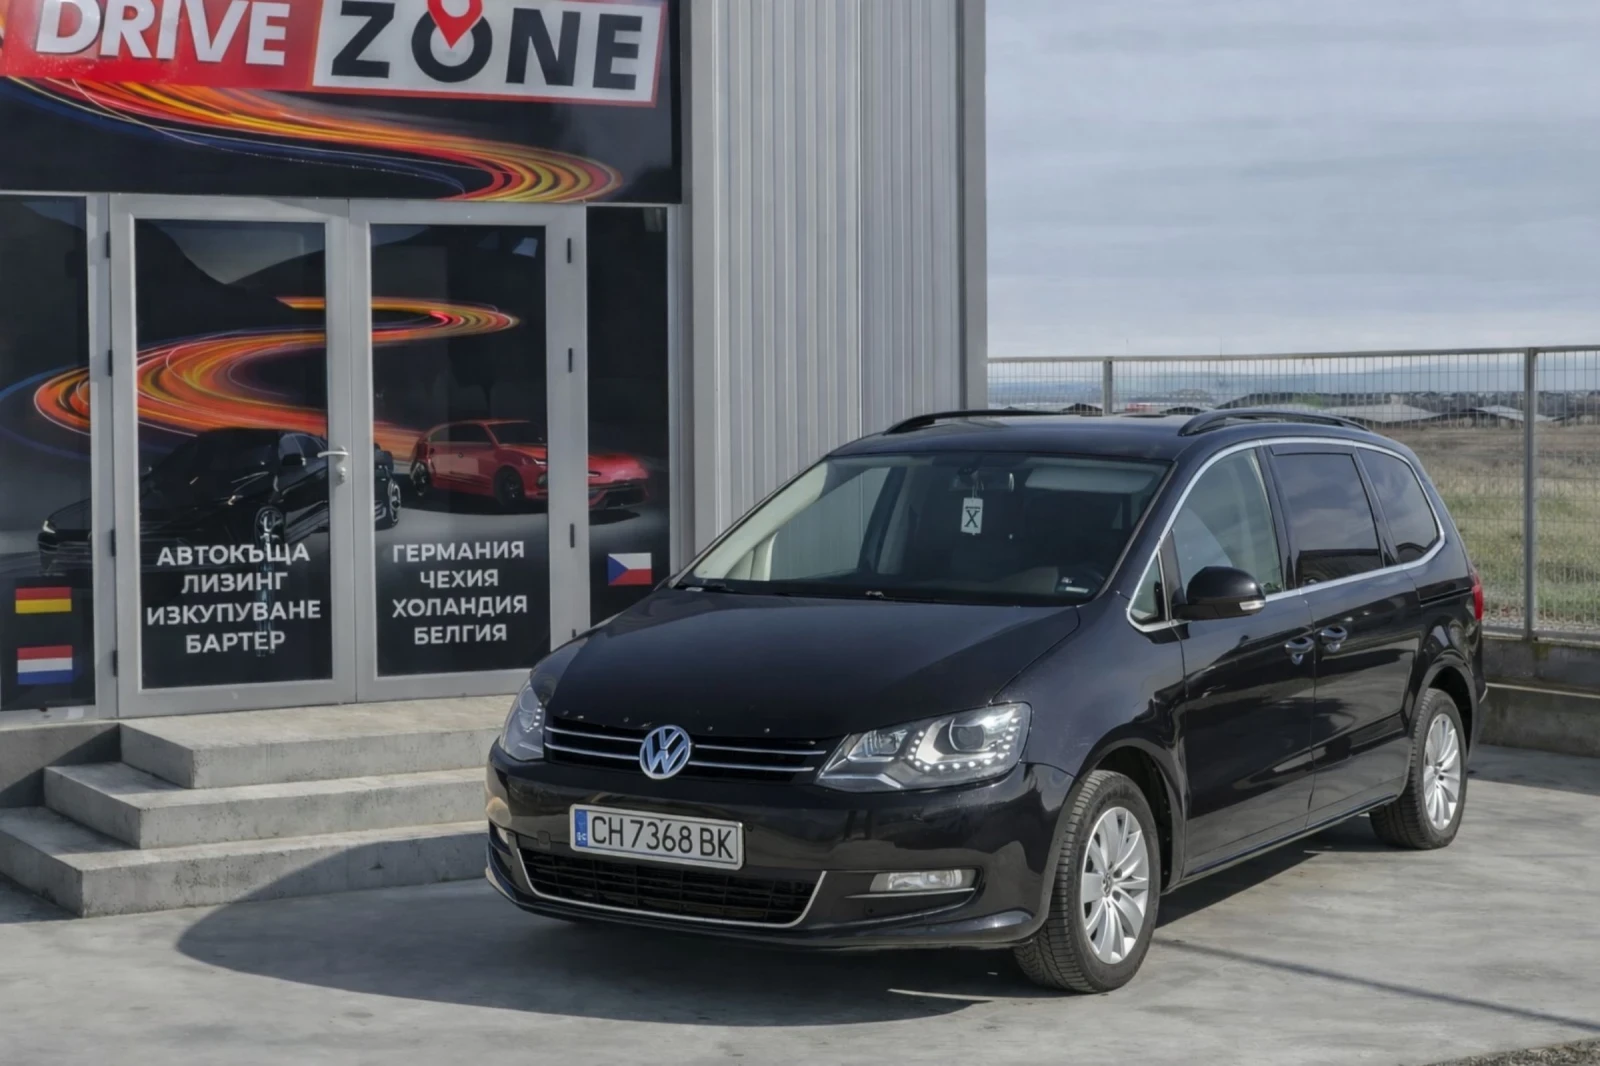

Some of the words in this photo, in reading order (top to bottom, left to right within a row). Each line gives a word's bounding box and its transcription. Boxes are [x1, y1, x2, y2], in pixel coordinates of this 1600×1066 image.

[36, 0, 291, 66] DRIVE
[331, 0, 643, 90] ZONE
[156, 543, 310, 566] АВТОКЪЩА
[392, 540, 525, 563] ГЕРМАНИЯ
[181, 572, 288, 594] ЛИЗИНГ
[420, 568, 499, 589] ЧЕХИЯ
[147, 600, 322, 626] ИЗКУПУВАНЕ
[392, 595, 528, 618] ХОЛАНДИЯ
[186, 631, 286, 654] БАРТЕР
[413, 623, 507, 645] БЕЛГИЯ
